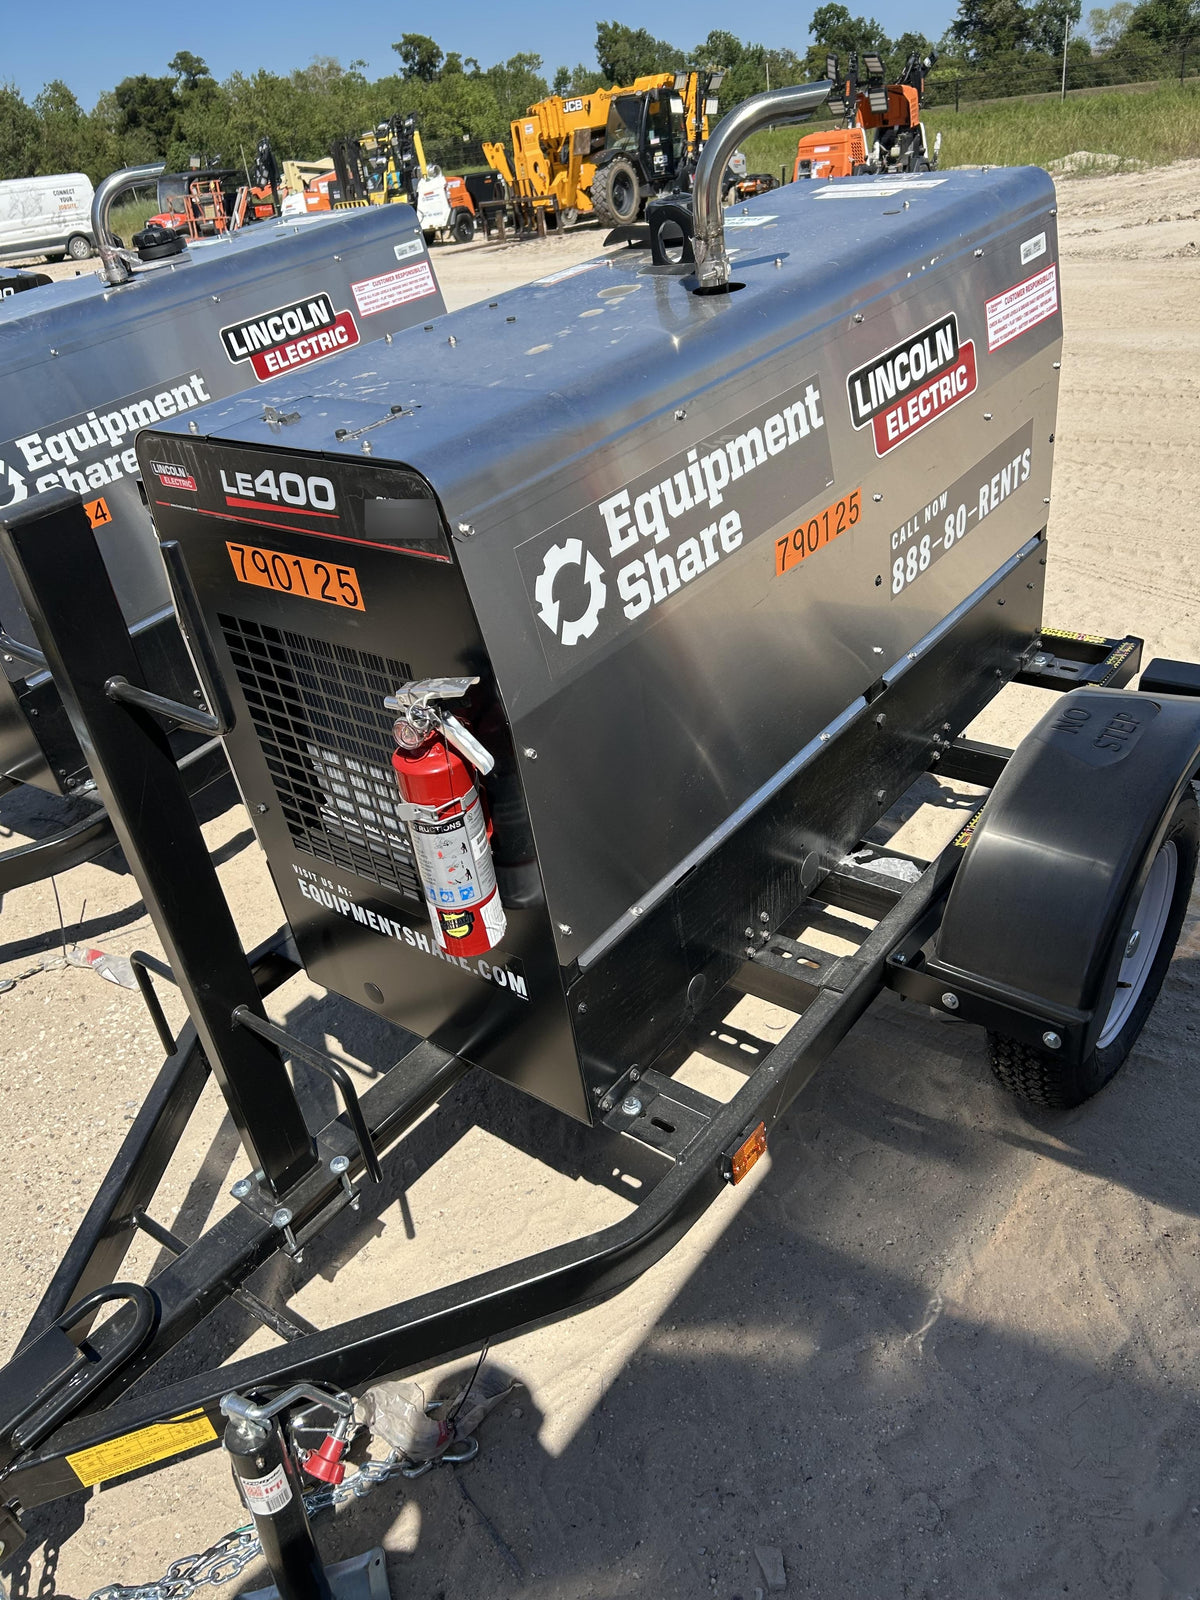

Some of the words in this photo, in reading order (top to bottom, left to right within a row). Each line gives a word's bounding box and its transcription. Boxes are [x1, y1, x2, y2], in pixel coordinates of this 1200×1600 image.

[562, 99, 583, 113] JCB
[53, 188, 75, 196] CONNECT
[1004, 288, 1026, 306] CUSTOMER
[228, 299, 331, 357] LINCOLN
[264, 325, 349, 373] ELECTRIC
[854, 323, 955, 419] LINCOLN
[15, 374, 211, 472] Equipment
[885, 364, 968, 442] ELECTRIC
[152, 463, 187, 479] LINCOLN
[163, 476, 193, 489] ELECTRIC
[219, 469, 336, 511] LE400
[598, 384, 824, 559] Equipment
[777, 491, 859, 572] 790125
[891, 515, 920, 550] CALL
[924, 490, 948, 524] NOW
[892, 447, 1031, 594] 888-80-RENTS
[230, 546, 358, 607] 790125
[616, 509, 744, 621] Share
[1051, 708, 1092, 735] NO
[1093, 712, 1140, 752] STEP
[292, 863, 318, 882] VISIT
[321, 877, 334, 890] US
[337, 884, 352, 897] AT:
